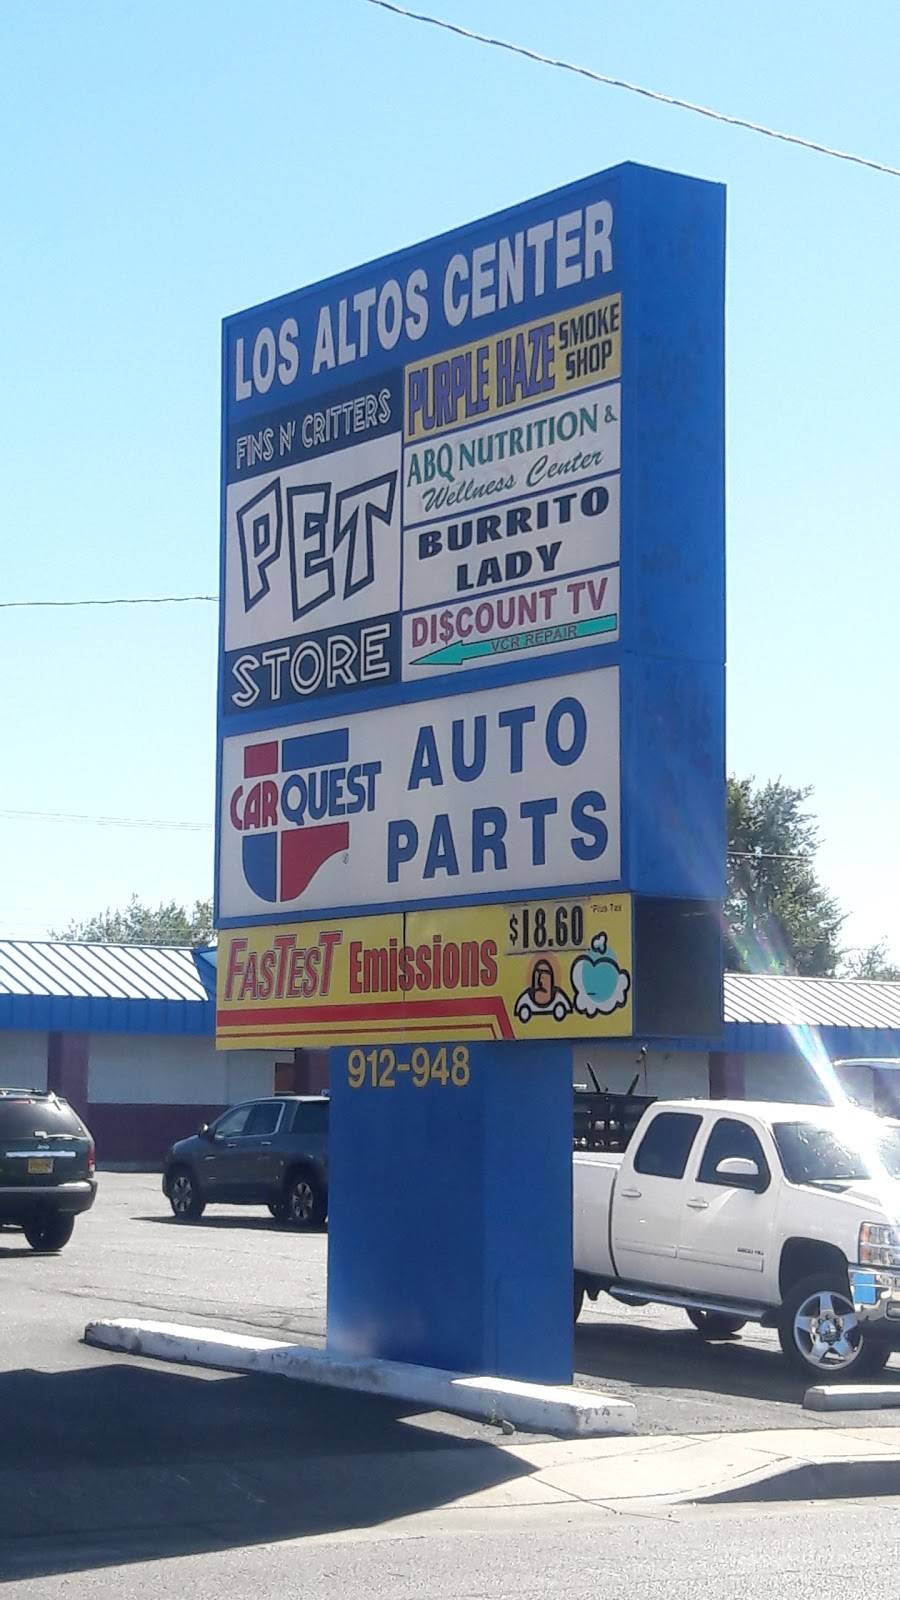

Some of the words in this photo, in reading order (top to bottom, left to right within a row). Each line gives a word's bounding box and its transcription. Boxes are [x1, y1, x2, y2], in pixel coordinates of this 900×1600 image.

[235, 317, 300, 402] LOS
[311, 269, 429, 375] ALTOS
[442, 200, 614, 328] CENTER
[559, 302, 620, 351] SMOKE
[407, 344, 490, 436] PURPLE
[496, 321, 556, 406] HAZE
[565, 340, 613, 380] SHOP
[236, 428, 274, 469] FINS
[301, 388, 392, 448] CRITTERS
[406, 443, 455, 487] ABQ
[459, 403, 599, 471] NUTRITION
[604, 405, 618, 424] &
[422, 474, 516, 513] Wellness
[526, 450, 604, 487] Center
[235, 469, 399, 623] PET
[418, 486, 610, 561] BURRITO
[456, 541, 563, 592] LADY
[411, 589, 558, 648] DI$COUNT
[566, 577, 609, 613] TV
[491, 637, 520, 652] VCR
[525, 625, 578, 648] REPAIR
[231, 623, 392, 709] STORE
[407, 696, 588, 791] AUTO
[387, 790, 609, 884] PARTS
[509, 905, 584, 949] $18.60
[349, 934, 498, 995] Emissions
[347, 1046, 471, 1088] 912-948
